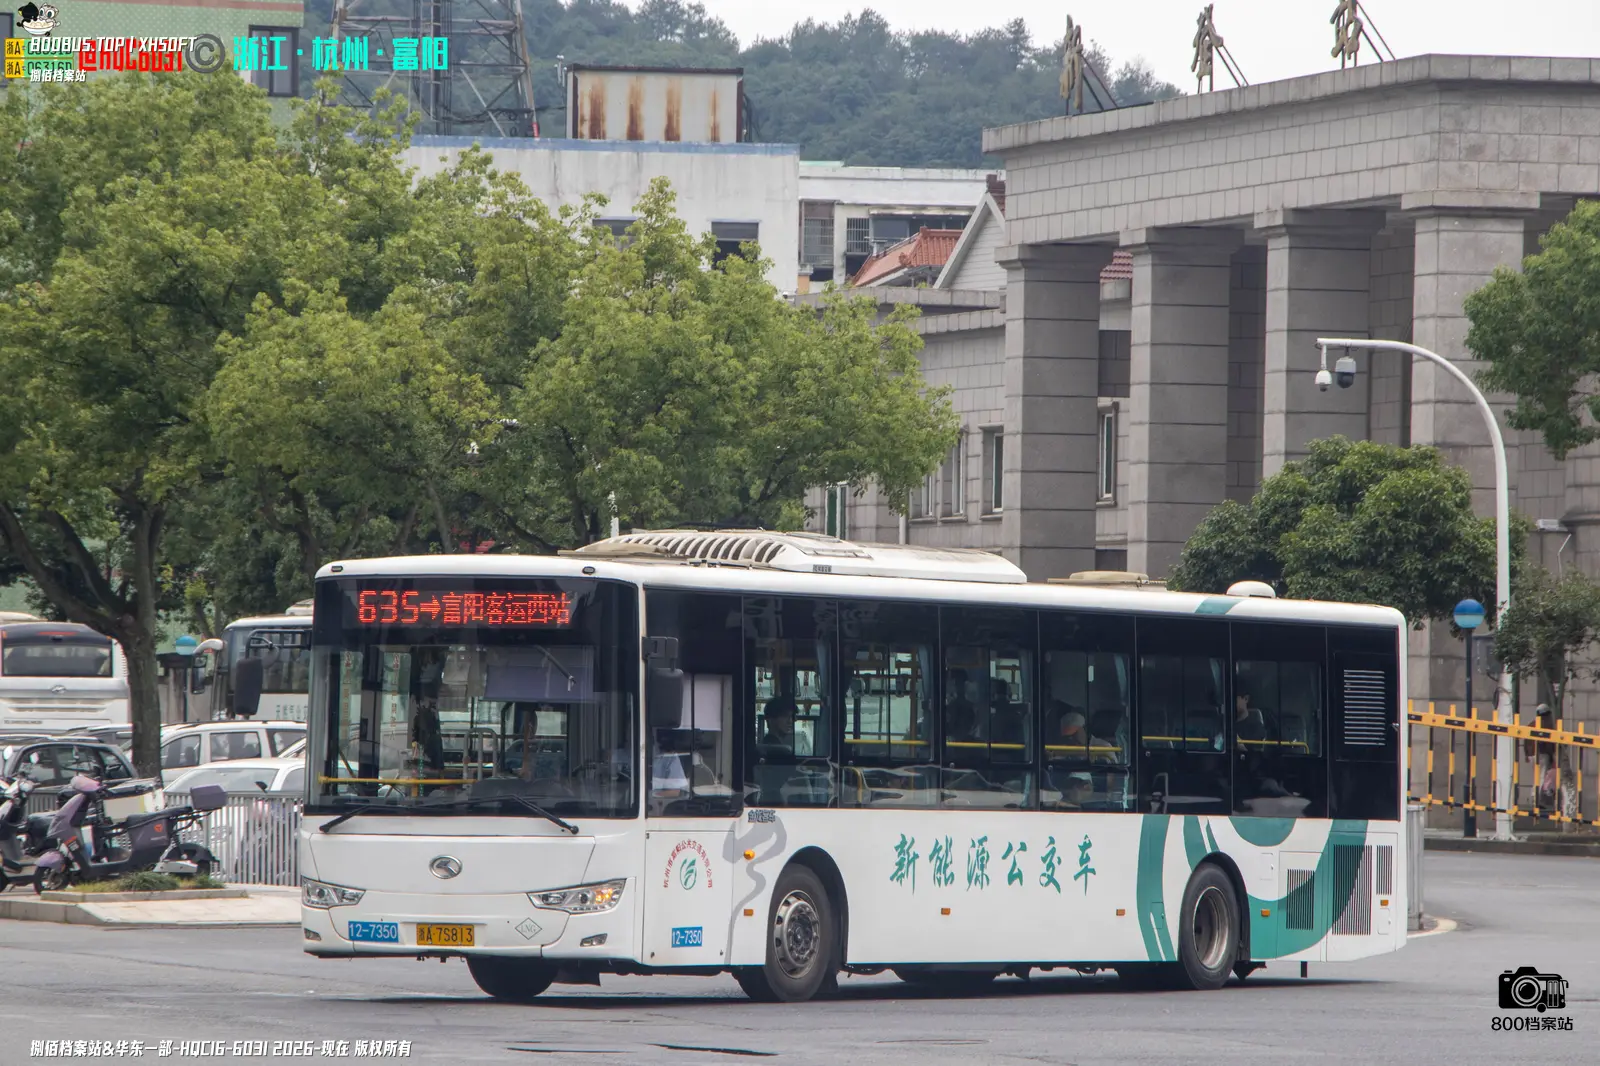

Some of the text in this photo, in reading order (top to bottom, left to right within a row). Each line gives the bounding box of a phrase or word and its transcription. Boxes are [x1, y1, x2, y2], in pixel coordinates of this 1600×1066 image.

[358, 590, 571, 625] 635 富阳客运西站
[889, 832, 1097, 896] 新能源公交车
[349, 923, 398, 940] 12-7350
[520, 925, 536, 933] LNG
[672, 930, 702, 945] 12-7350
